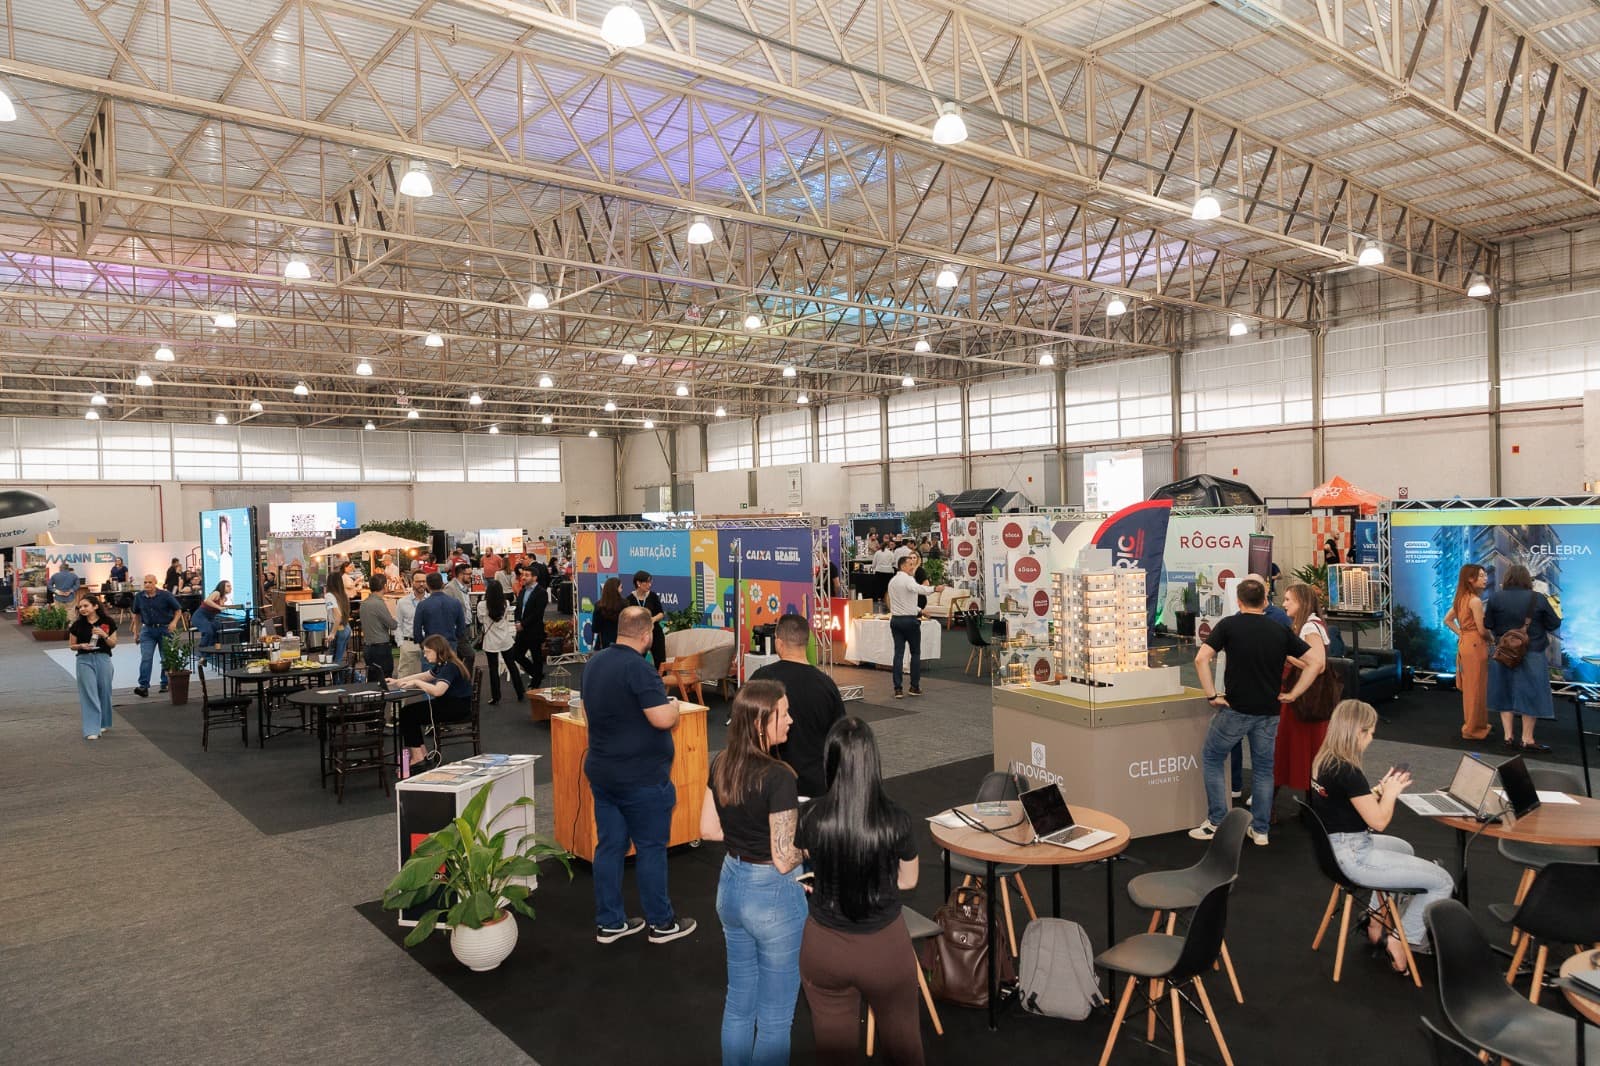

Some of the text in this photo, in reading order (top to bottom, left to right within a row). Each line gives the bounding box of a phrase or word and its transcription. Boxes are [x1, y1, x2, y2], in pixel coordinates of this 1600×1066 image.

[1180, 531, 1243, 548] RÔGGA
[630, 545, 677, 560] HABITAÇÃO É
[746, 549, 771, 561] CAIXA
[774, 550, 801, 562] BRASIL
[1530, 544, 1592, 555] CELEBRA
[1016, 761, 1064, 787] INOVARIC
[1129, 755, 1198, 778] CELEBRA
